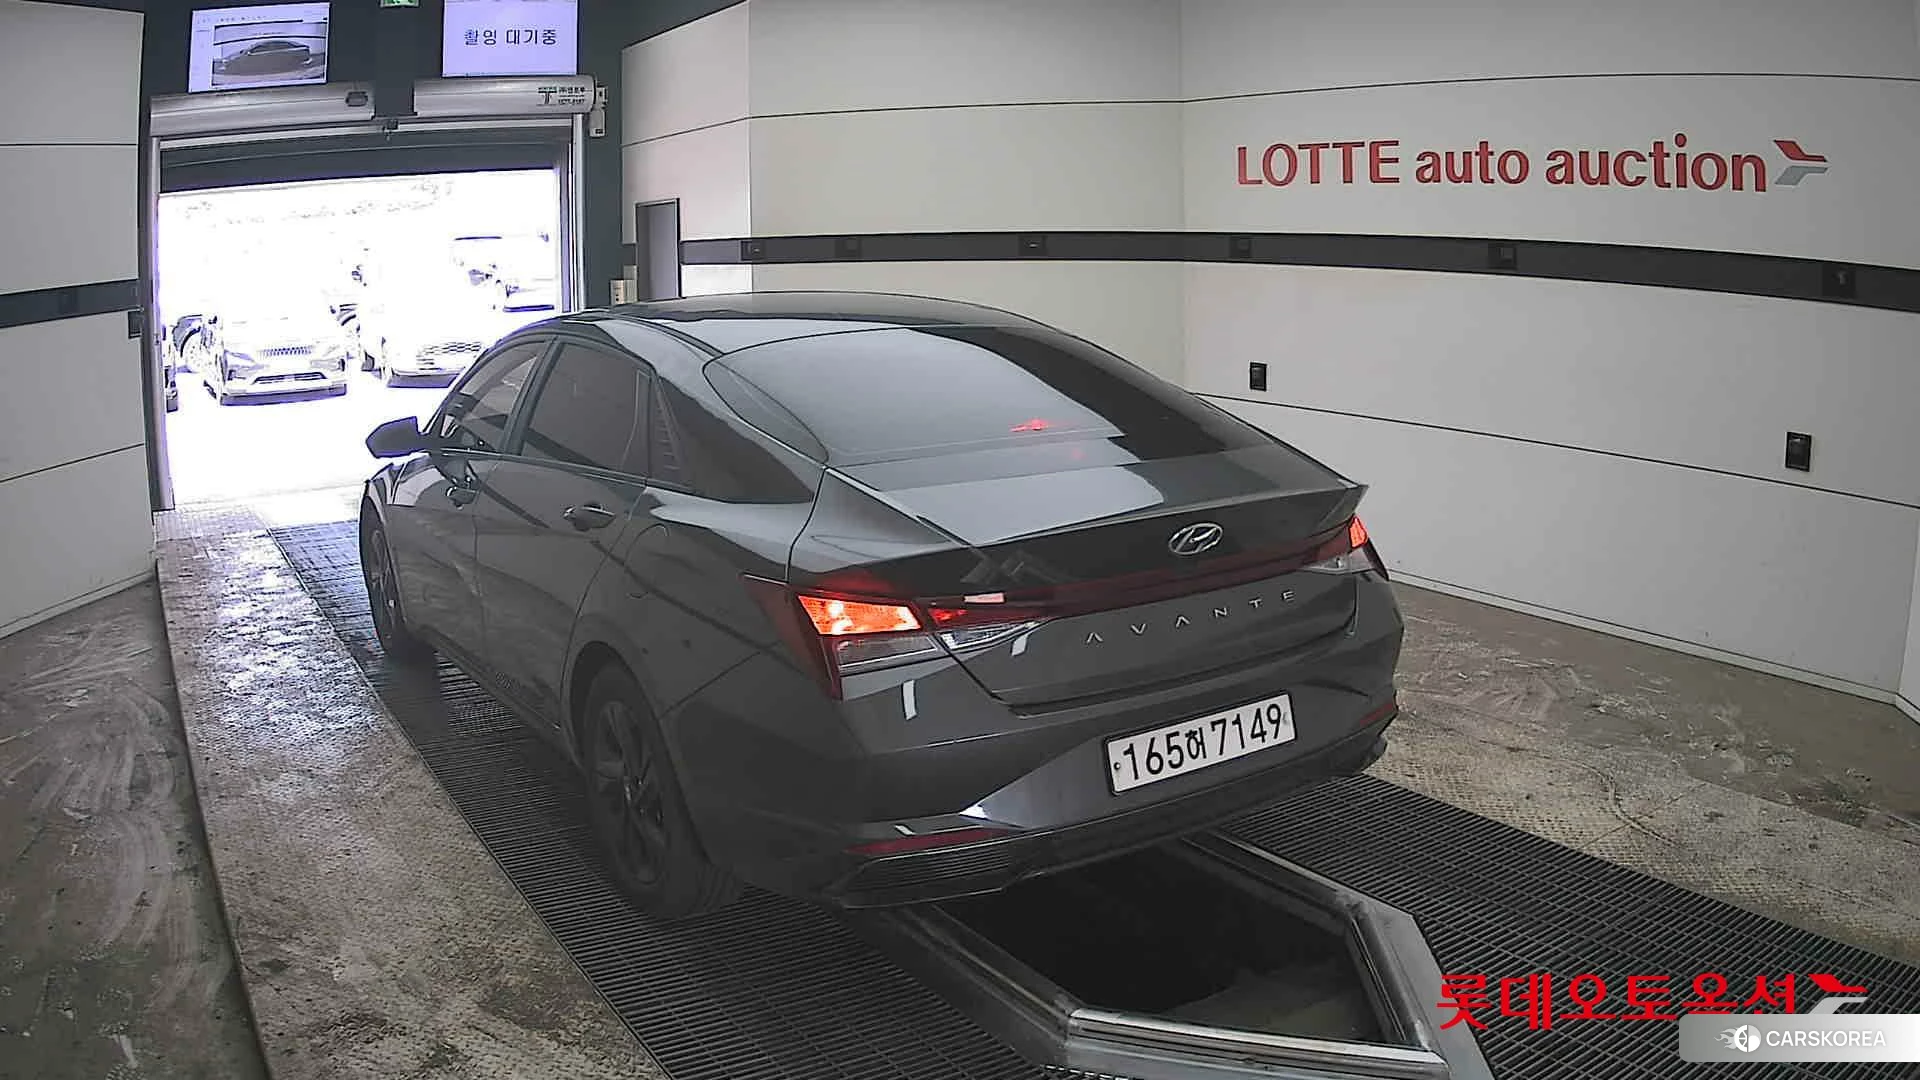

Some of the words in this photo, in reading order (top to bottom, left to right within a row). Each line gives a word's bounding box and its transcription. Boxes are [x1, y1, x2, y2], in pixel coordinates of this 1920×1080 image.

[506, 29, 557, 46] 대기중
[1236, 139, 1401, 187] LOTTE
[1415, 140, 1530, 185] auto
[1545, 132, 1767, 193] auction
[1086, 590, 1296, 644] AVANTE
